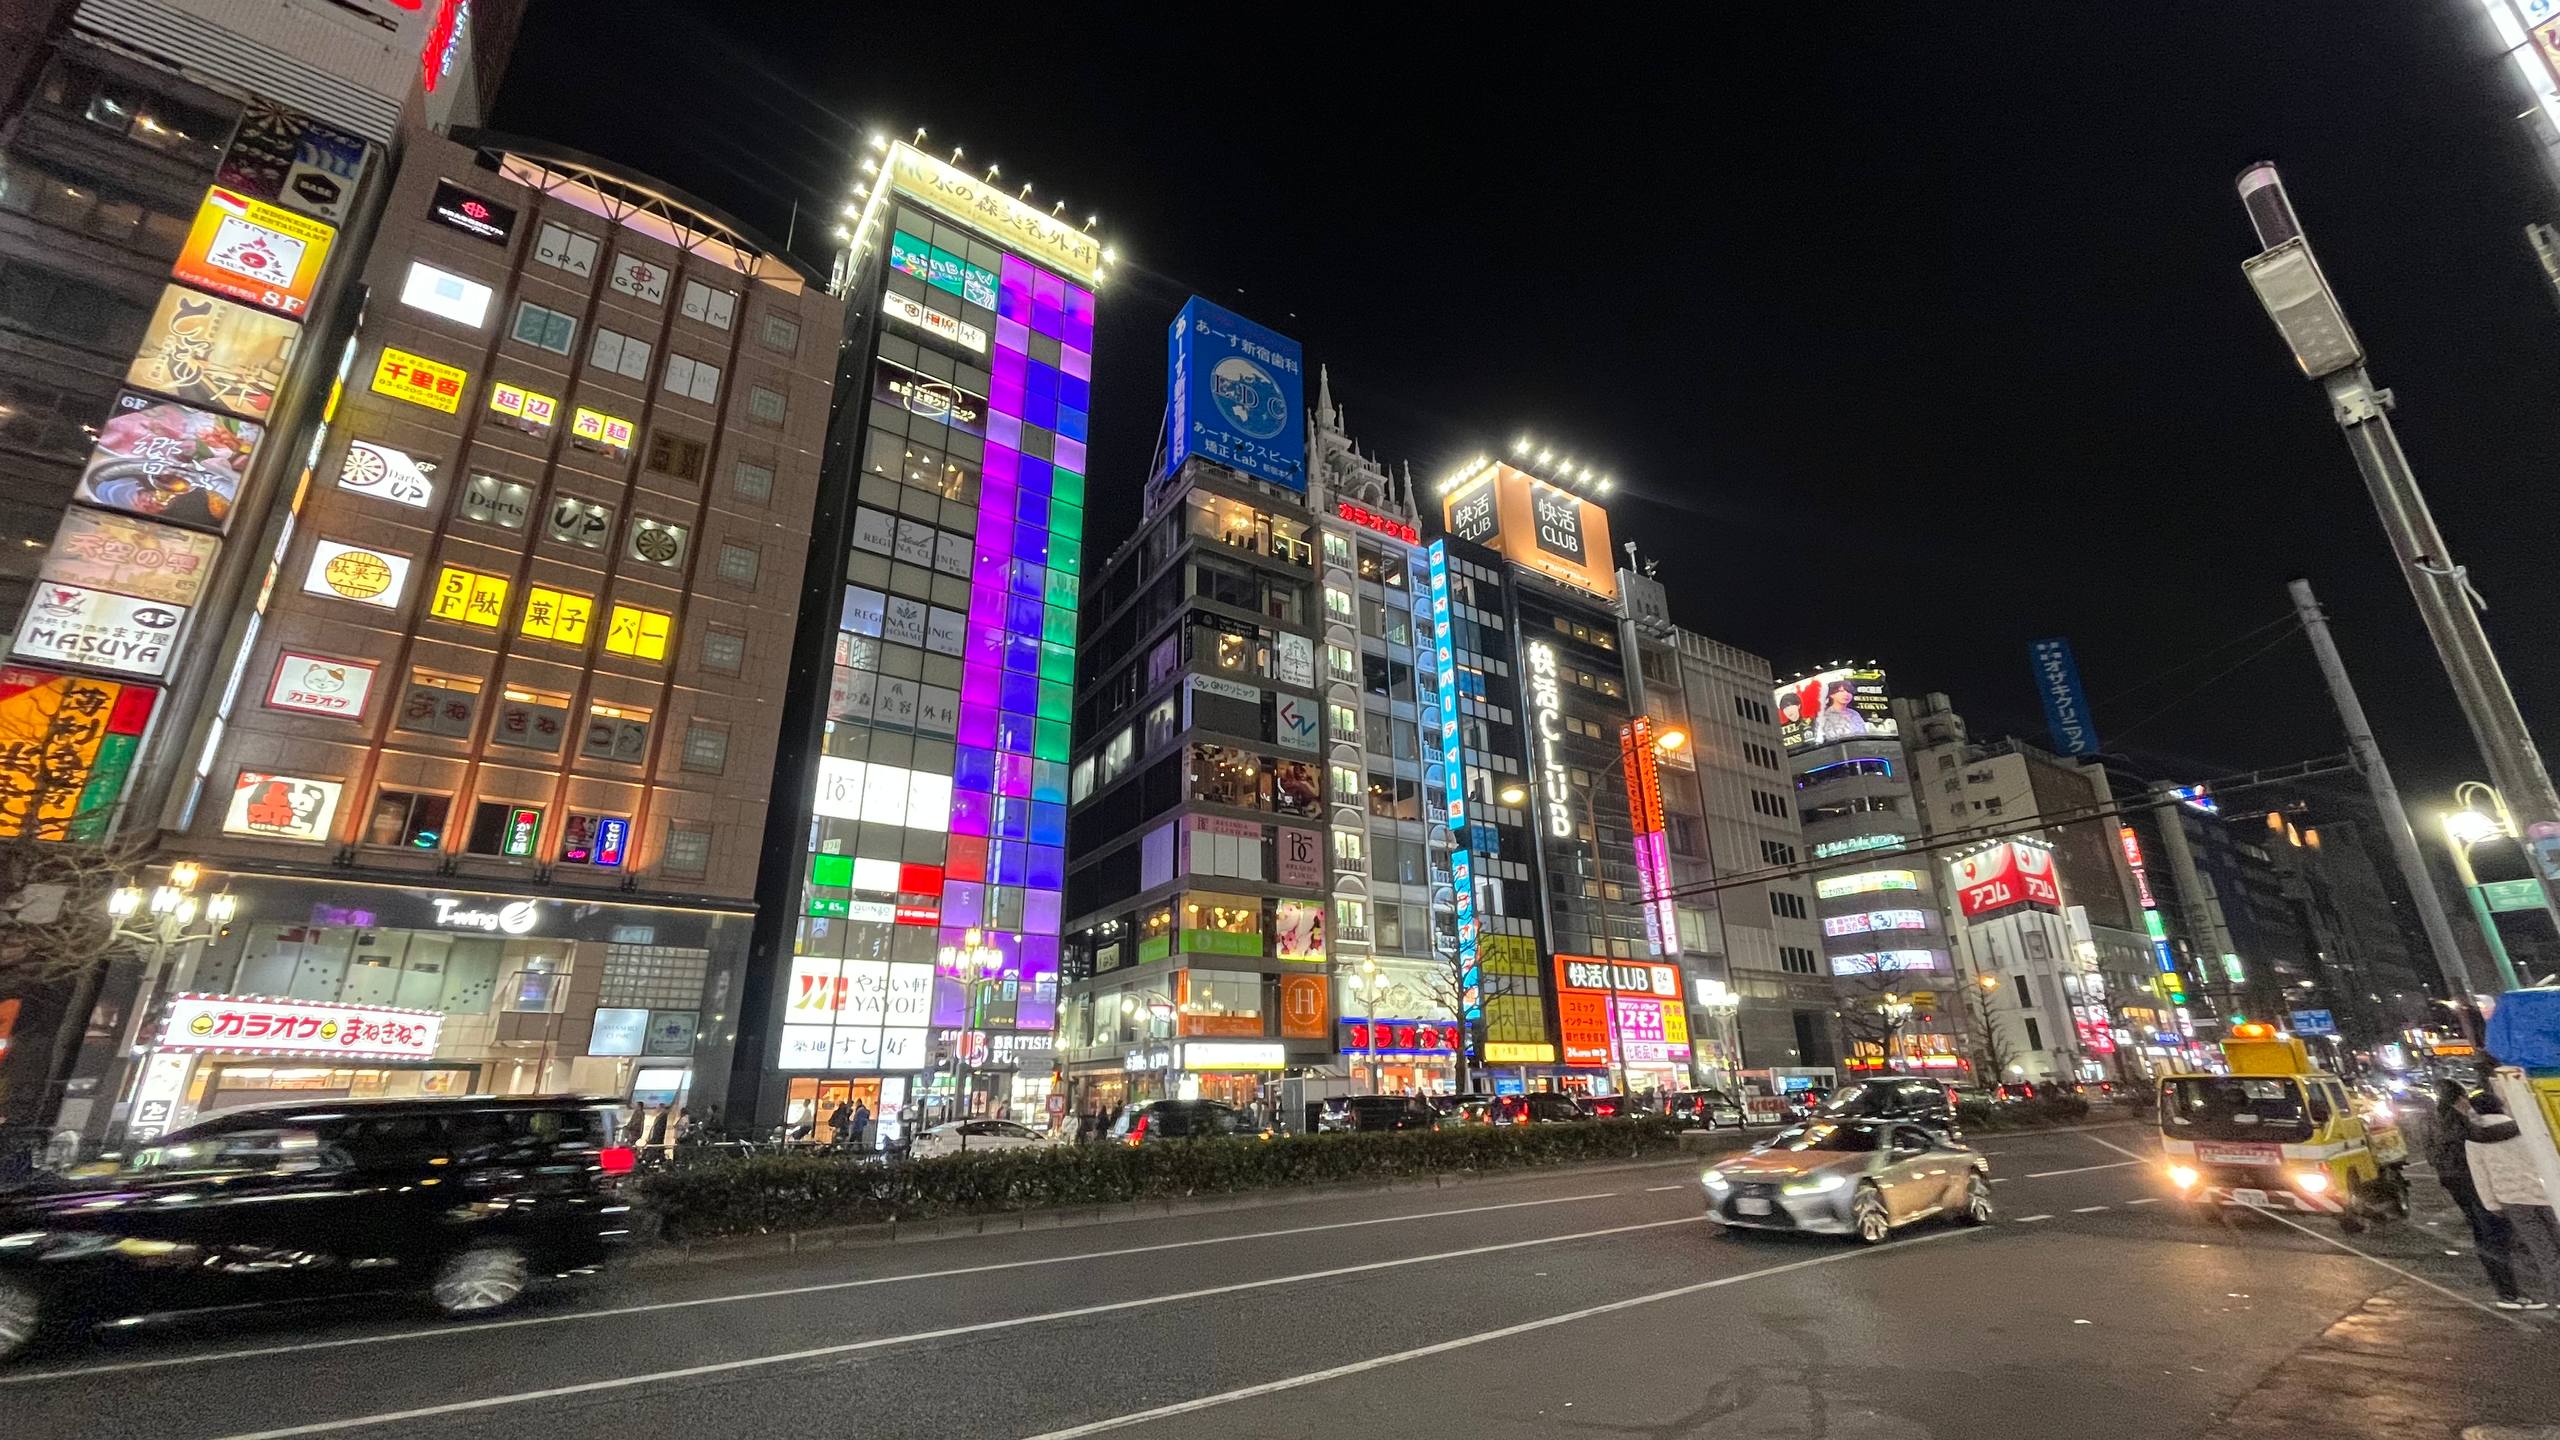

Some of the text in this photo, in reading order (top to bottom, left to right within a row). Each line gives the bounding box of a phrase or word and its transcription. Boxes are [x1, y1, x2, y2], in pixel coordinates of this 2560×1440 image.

[540, 246, 728, 325] DRA GON GYM
[261, 289, 306, 315] 8F
[1196, 319, 1299, 376] あーす新宿歯科
[384, 361, 460, 399] 千里香
[120, 396, 149, 411] 6F
[391, 483, 424, 502] UP
[468, 490, 525, 517] Darts
[555, 502, 609, 534] UP
[1455, 492, 1490, 529] 快活
[1538, 498, 1576, 533] 快活
[1458, 516, 1492, 541] CLUB
[1541, 525, 1579, 553] CLUB
[136, 609, 177, 628] 4F
[854, 608, 909, 632] REGINA
[27, 626, 160, 663] MASUYA
[1529, 640, 1573, 838] 快活CLUB
[1969, 889, 2011, 909] アコム
[2026, 876, 2057, 898] アコム
[1569, 1002, 1596, 1013] コミック
[213, 1011, 323, 1045] カラオケ
[340, 1016, 427, 1052] まねきねこ
[993, 1035, 1053, 1050] BRITISH
[992, 1050, 1020, 1065] PU
